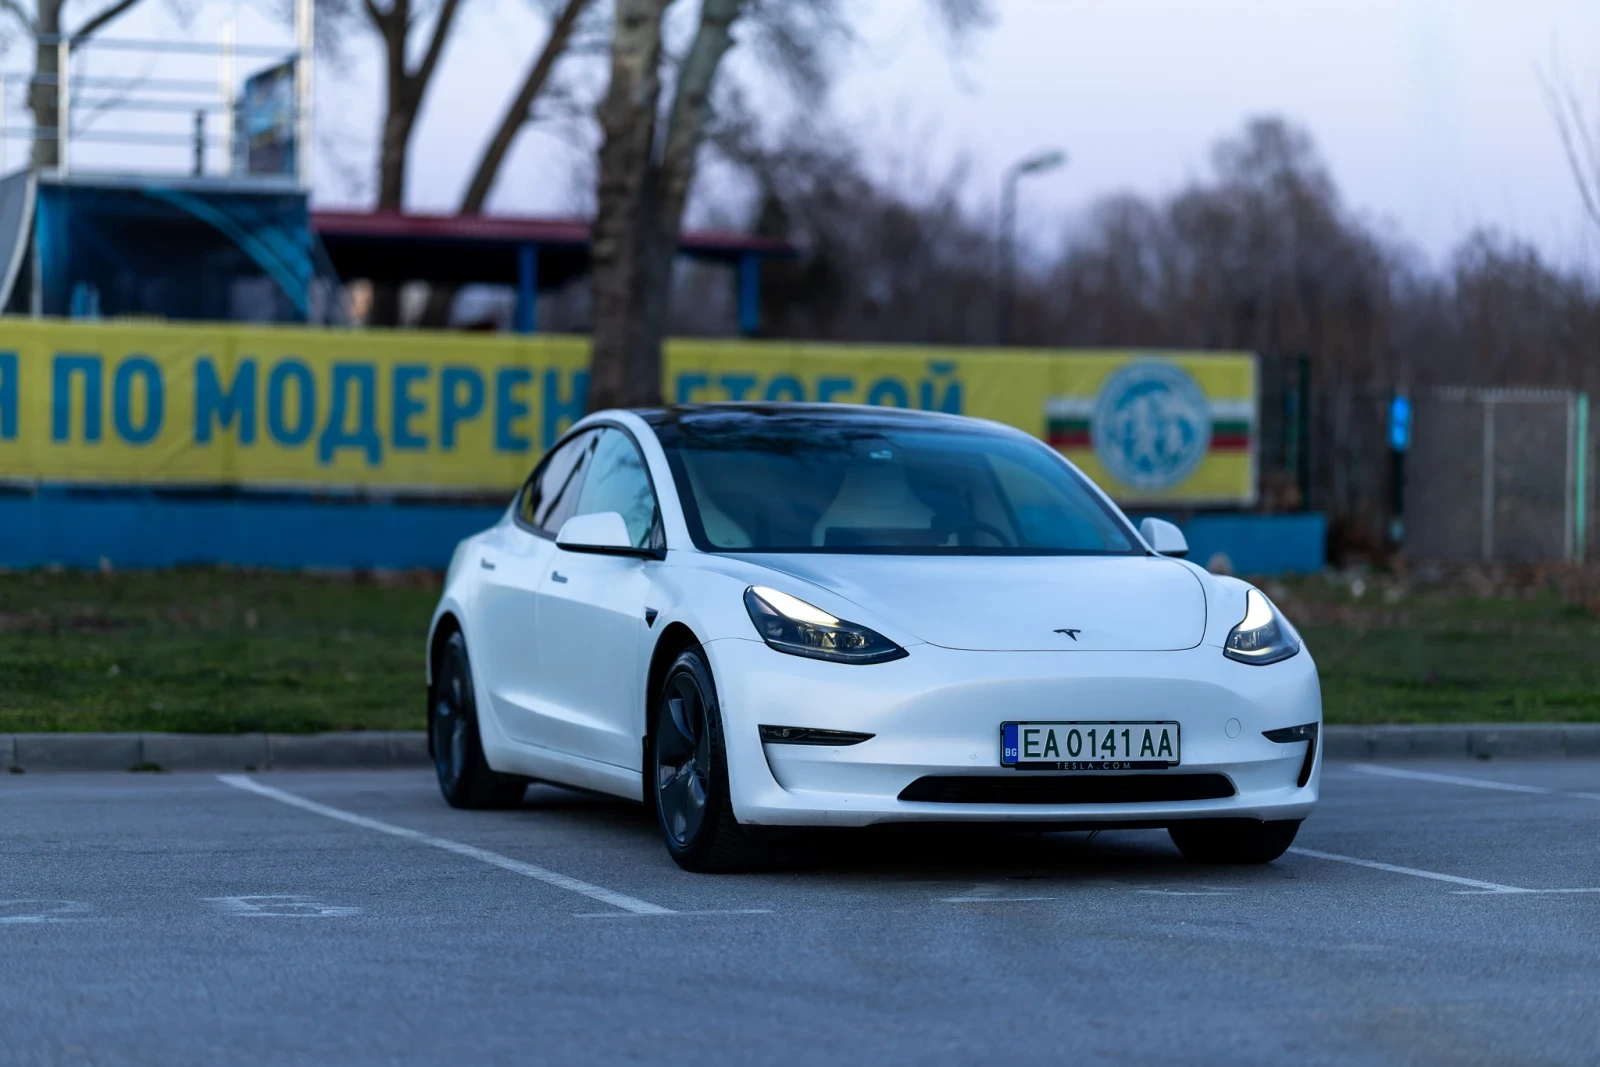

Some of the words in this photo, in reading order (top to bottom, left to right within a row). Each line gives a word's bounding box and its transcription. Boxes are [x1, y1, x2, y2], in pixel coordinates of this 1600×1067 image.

[50, 353, 166, 446] ПО
[193, 354, 590, 468] МОДЕРЕН
[1139, 728, 1173, 757] AA
[1004, 748, 1018, 757] BG
[1056, 761, 1132, 770] TESLA.COM
